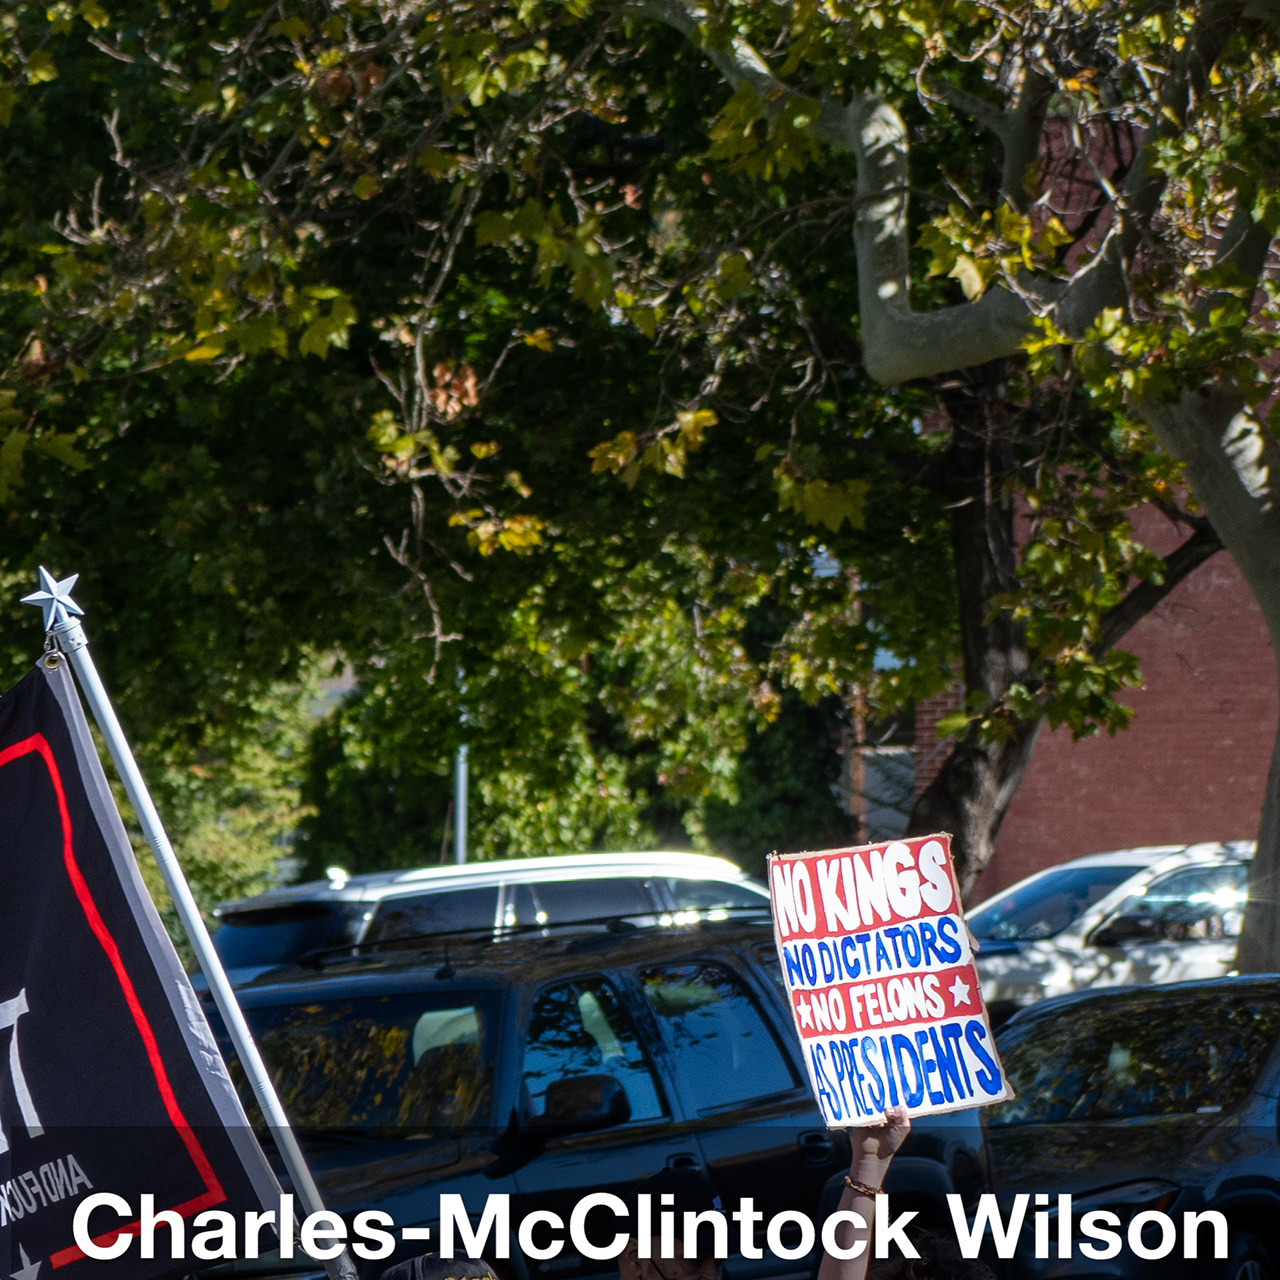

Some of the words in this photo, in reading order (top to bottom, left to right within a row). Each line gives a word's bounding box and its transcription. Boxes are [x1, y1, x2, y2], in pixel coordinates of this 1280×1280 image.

[772, 860, 817, 937] NO
[817, 840, 953, 932] KINGS
[783, 941, 817, 987] NO
[818, 916, 962, 982] DICTATORS
[810, 988, 846, 1032] NO
[850, 973, 945, 1029] FELONS
[810, 1043, 842, 1122] AS
[829, 1020, 1002, 1118] PRESIDENTS
